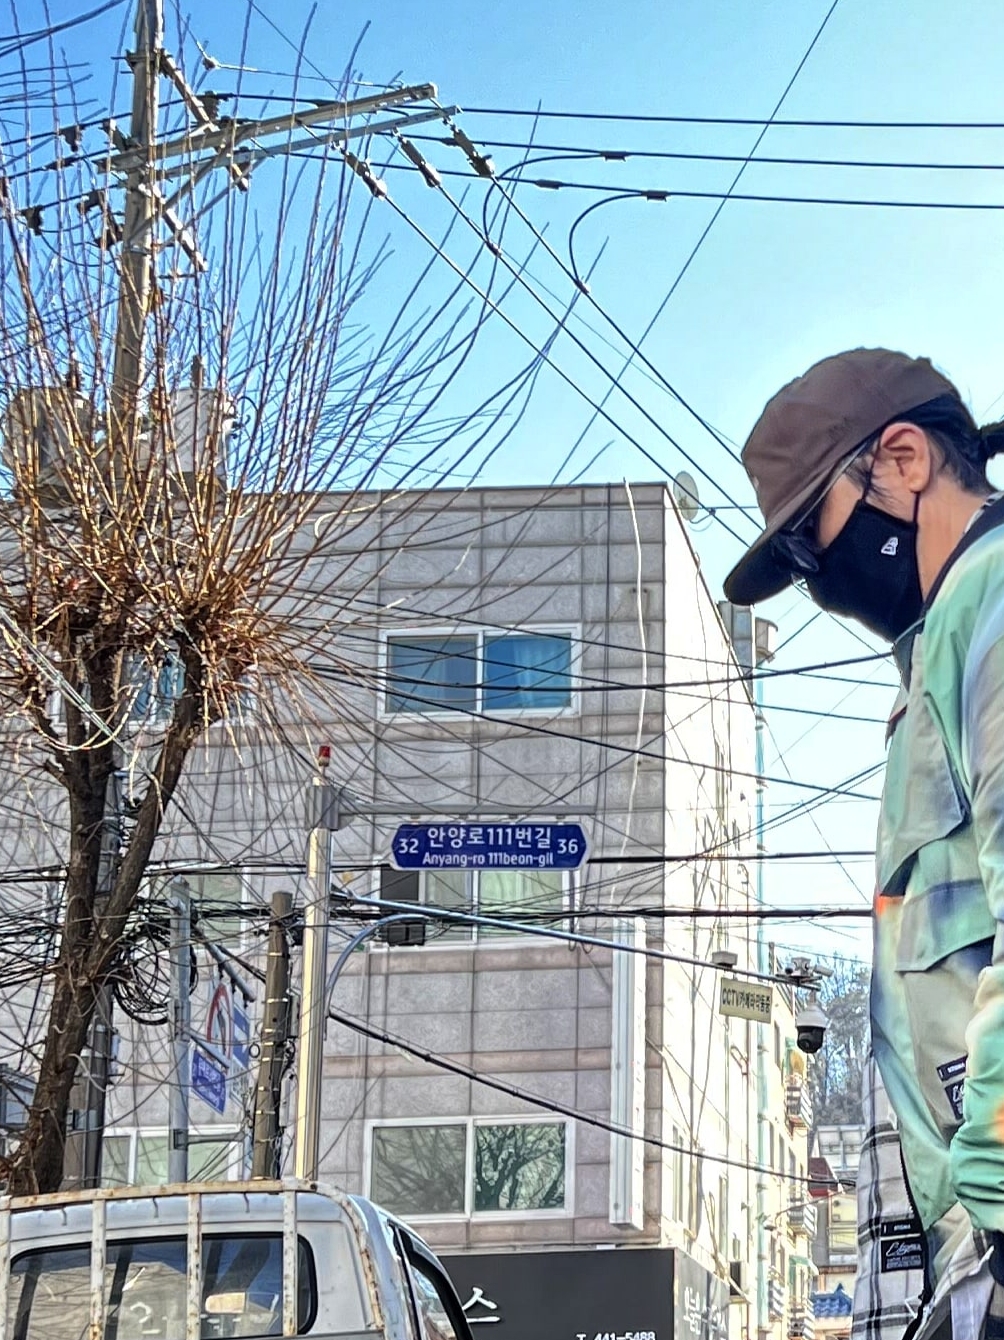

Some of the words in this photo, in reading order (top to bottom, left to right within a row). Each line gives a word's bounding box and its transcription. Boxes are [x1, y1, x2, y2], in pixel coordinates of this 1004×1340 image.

[398, 838, 419, 854] 32
[427, 827, 552, 849] 안양로111번길
[557, 839, 579, 854] 36
[422, 852, 485, 867] Anyang-ro
[488, 852, 554, 867] 111beon-gil
